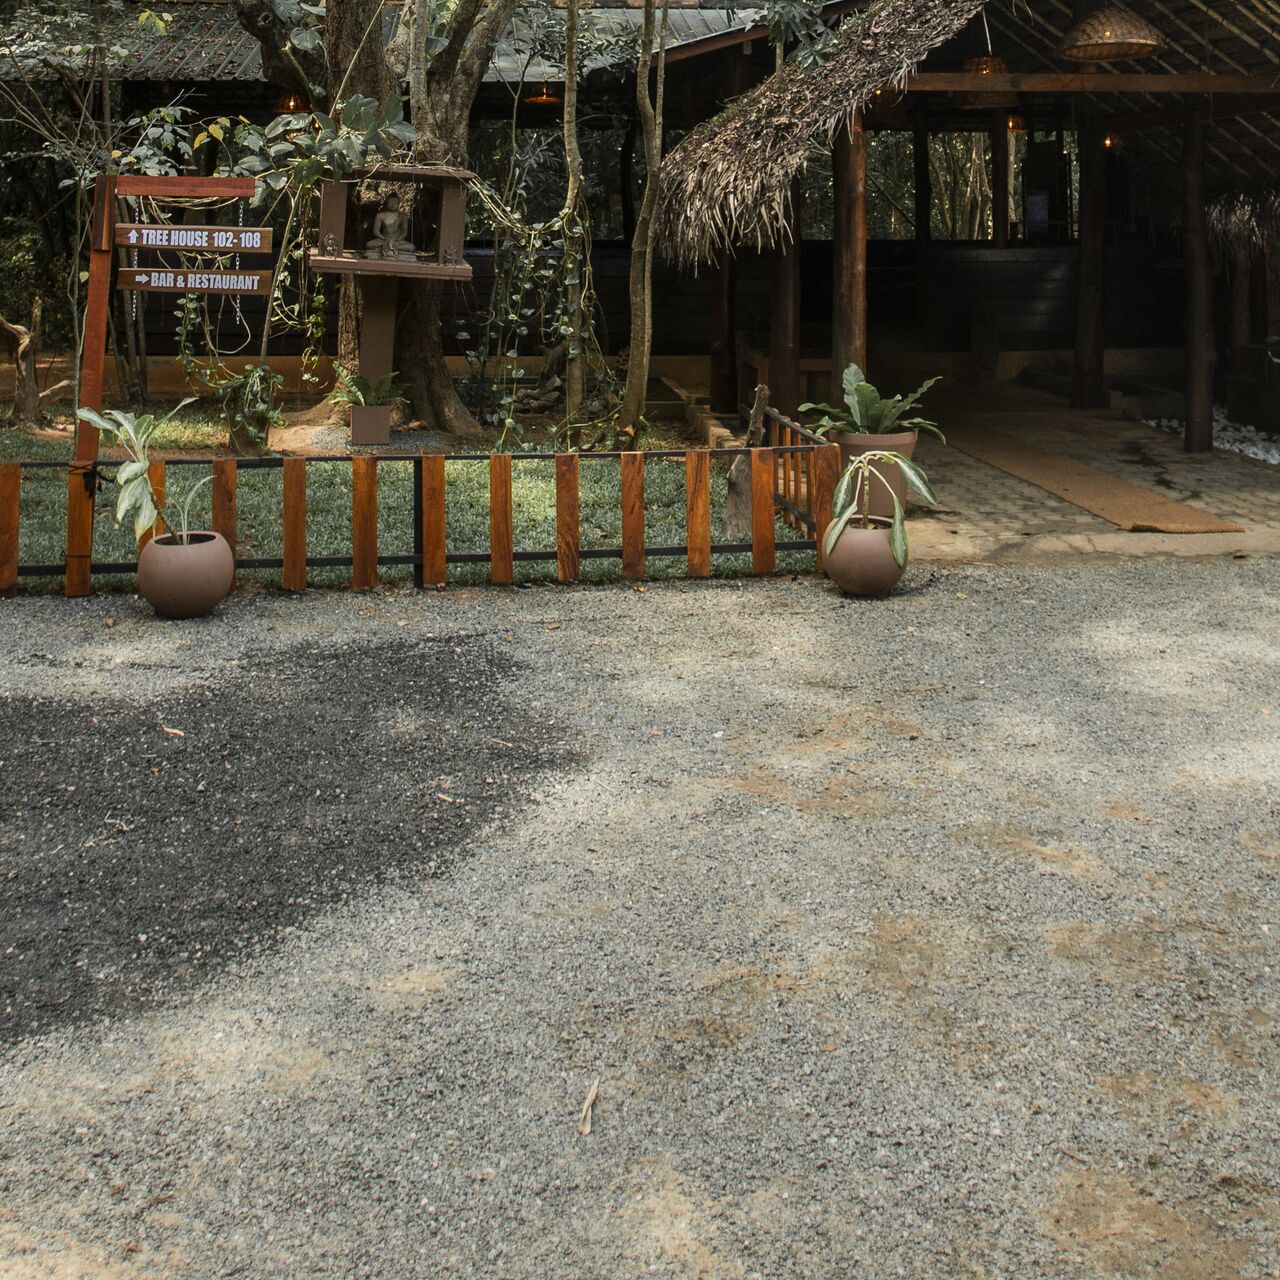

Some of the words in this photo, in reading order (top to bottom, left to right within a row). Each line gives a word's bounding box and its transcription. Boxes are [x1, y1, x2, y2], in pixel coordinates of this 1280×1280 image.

[142, 230, 169, 245] TREE
[170, 231, 208, 247] HOUSE
[240, 232, 261, 248] 108
[151, 272, 174, 287] BAR
[176, 275, 185, 288] &
[188, 274, 260, 290] RESTAURANT
